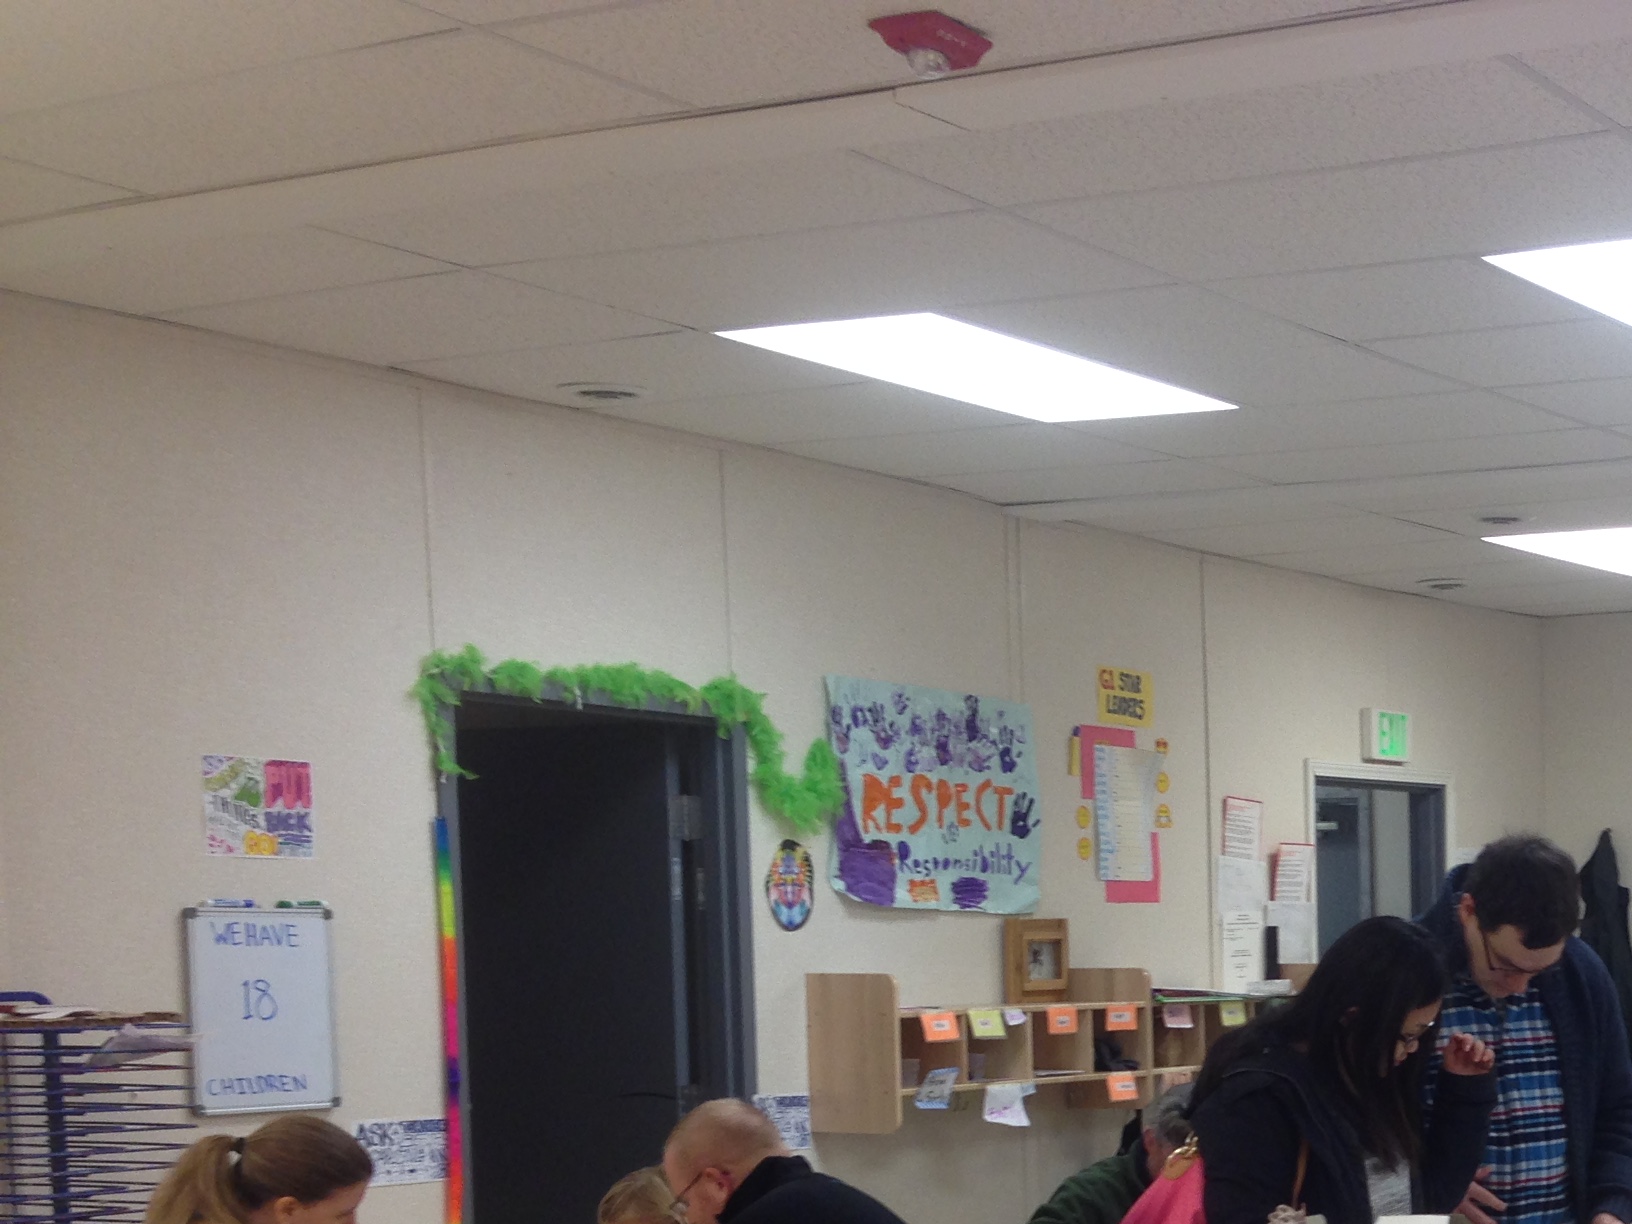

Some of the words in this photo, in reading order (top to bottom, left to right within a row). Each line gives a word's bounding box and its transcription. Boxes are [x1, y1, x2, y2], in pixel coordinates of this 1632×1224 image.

[1379, 711, 1409, 757] EXIT
[861, 772, 1014, 836] RESPECT
[897, 841, 1034, 885] Responsibility
[210, 921, 243, 946] WE
[245, 922, 300, 947] HAVE
[241, 979, 279, 1021] 18
[206, 1074, 308, 1095] CHILDREN
